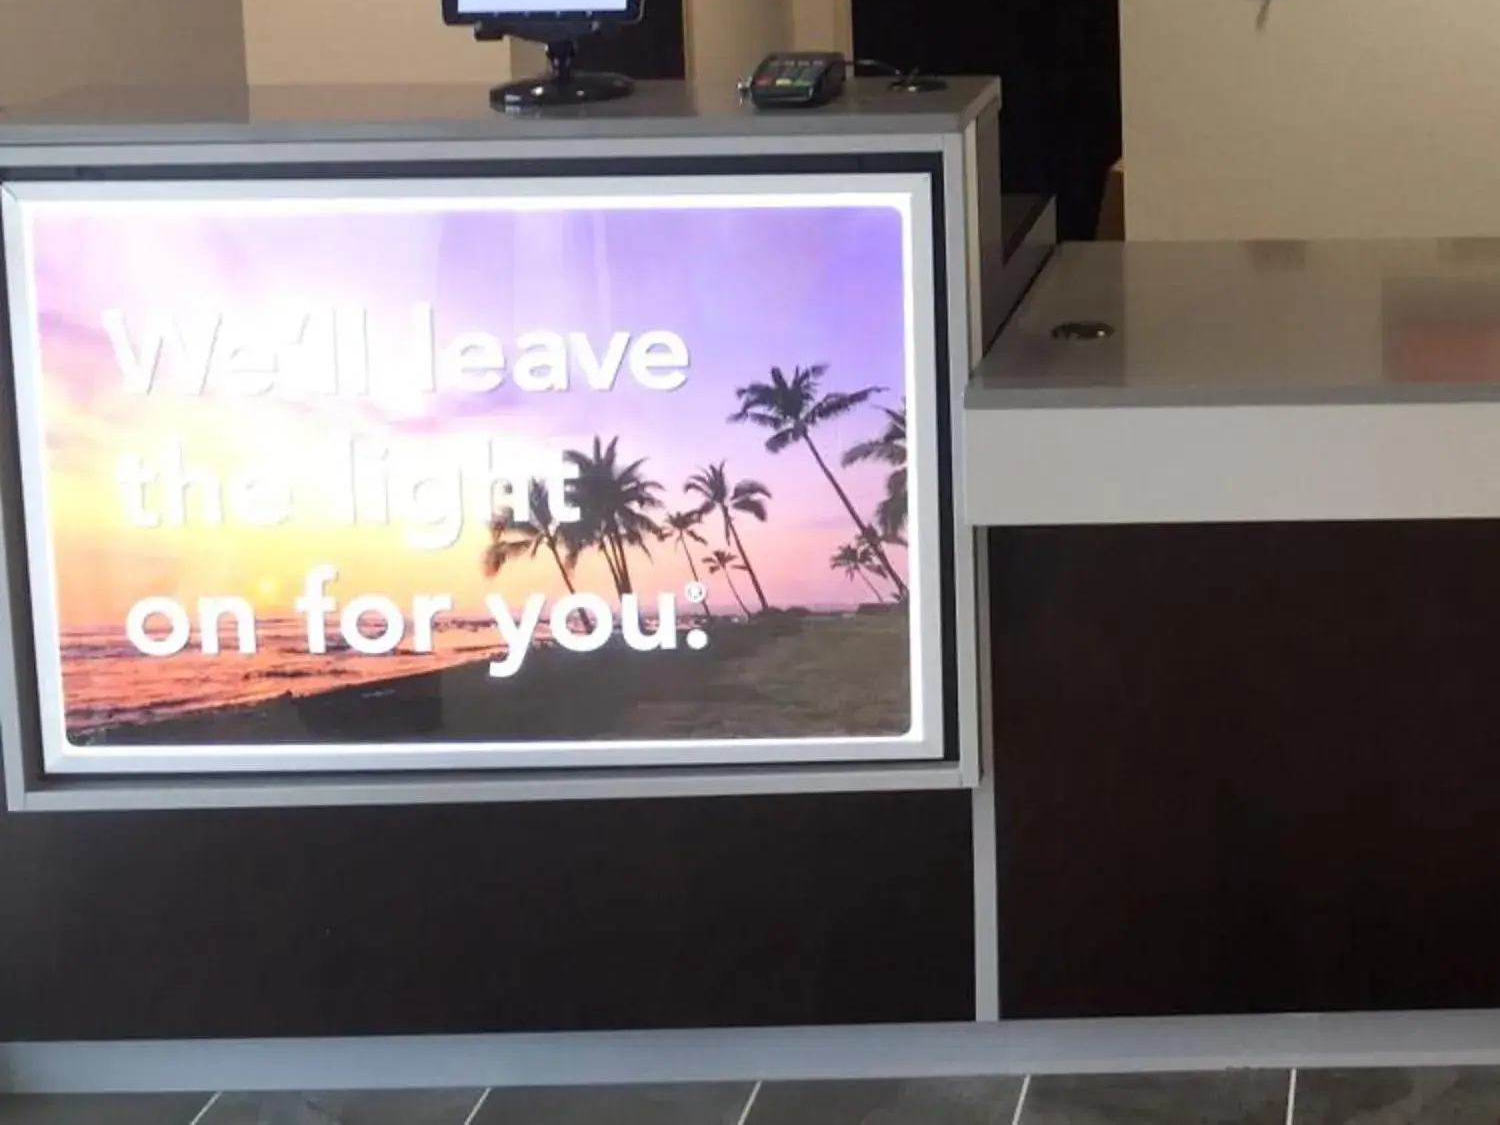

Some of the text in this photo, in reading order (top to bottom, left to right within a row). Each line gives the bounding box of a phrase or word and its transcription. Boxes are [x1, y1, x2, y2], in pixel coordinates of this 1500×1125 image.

[101, 301, 690, 397] We'll leave
[115, 433, 582, 554] the light
[126, 595, 257, 656] on
[295, 563, 452, 654] for
